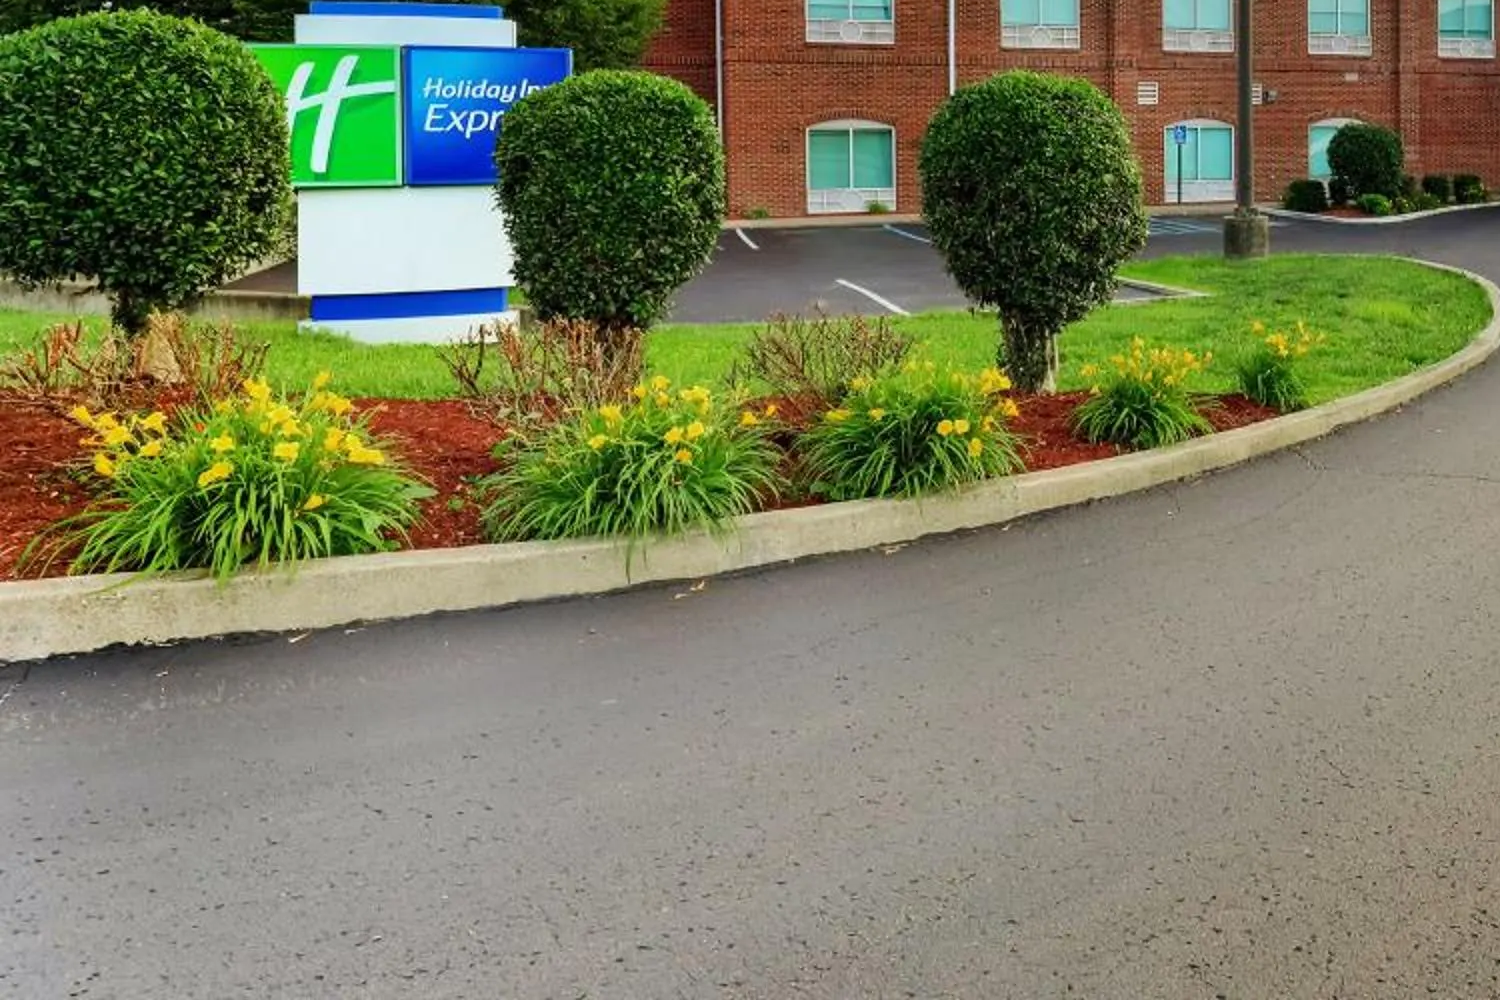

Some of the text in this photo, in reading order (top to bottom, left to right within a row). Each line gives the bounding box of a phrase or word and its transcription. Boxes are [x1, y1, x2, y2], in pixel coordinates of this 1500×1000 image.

[423, 77, 549, 103] Holiday In
[424, 103, 505, 139] Expr
